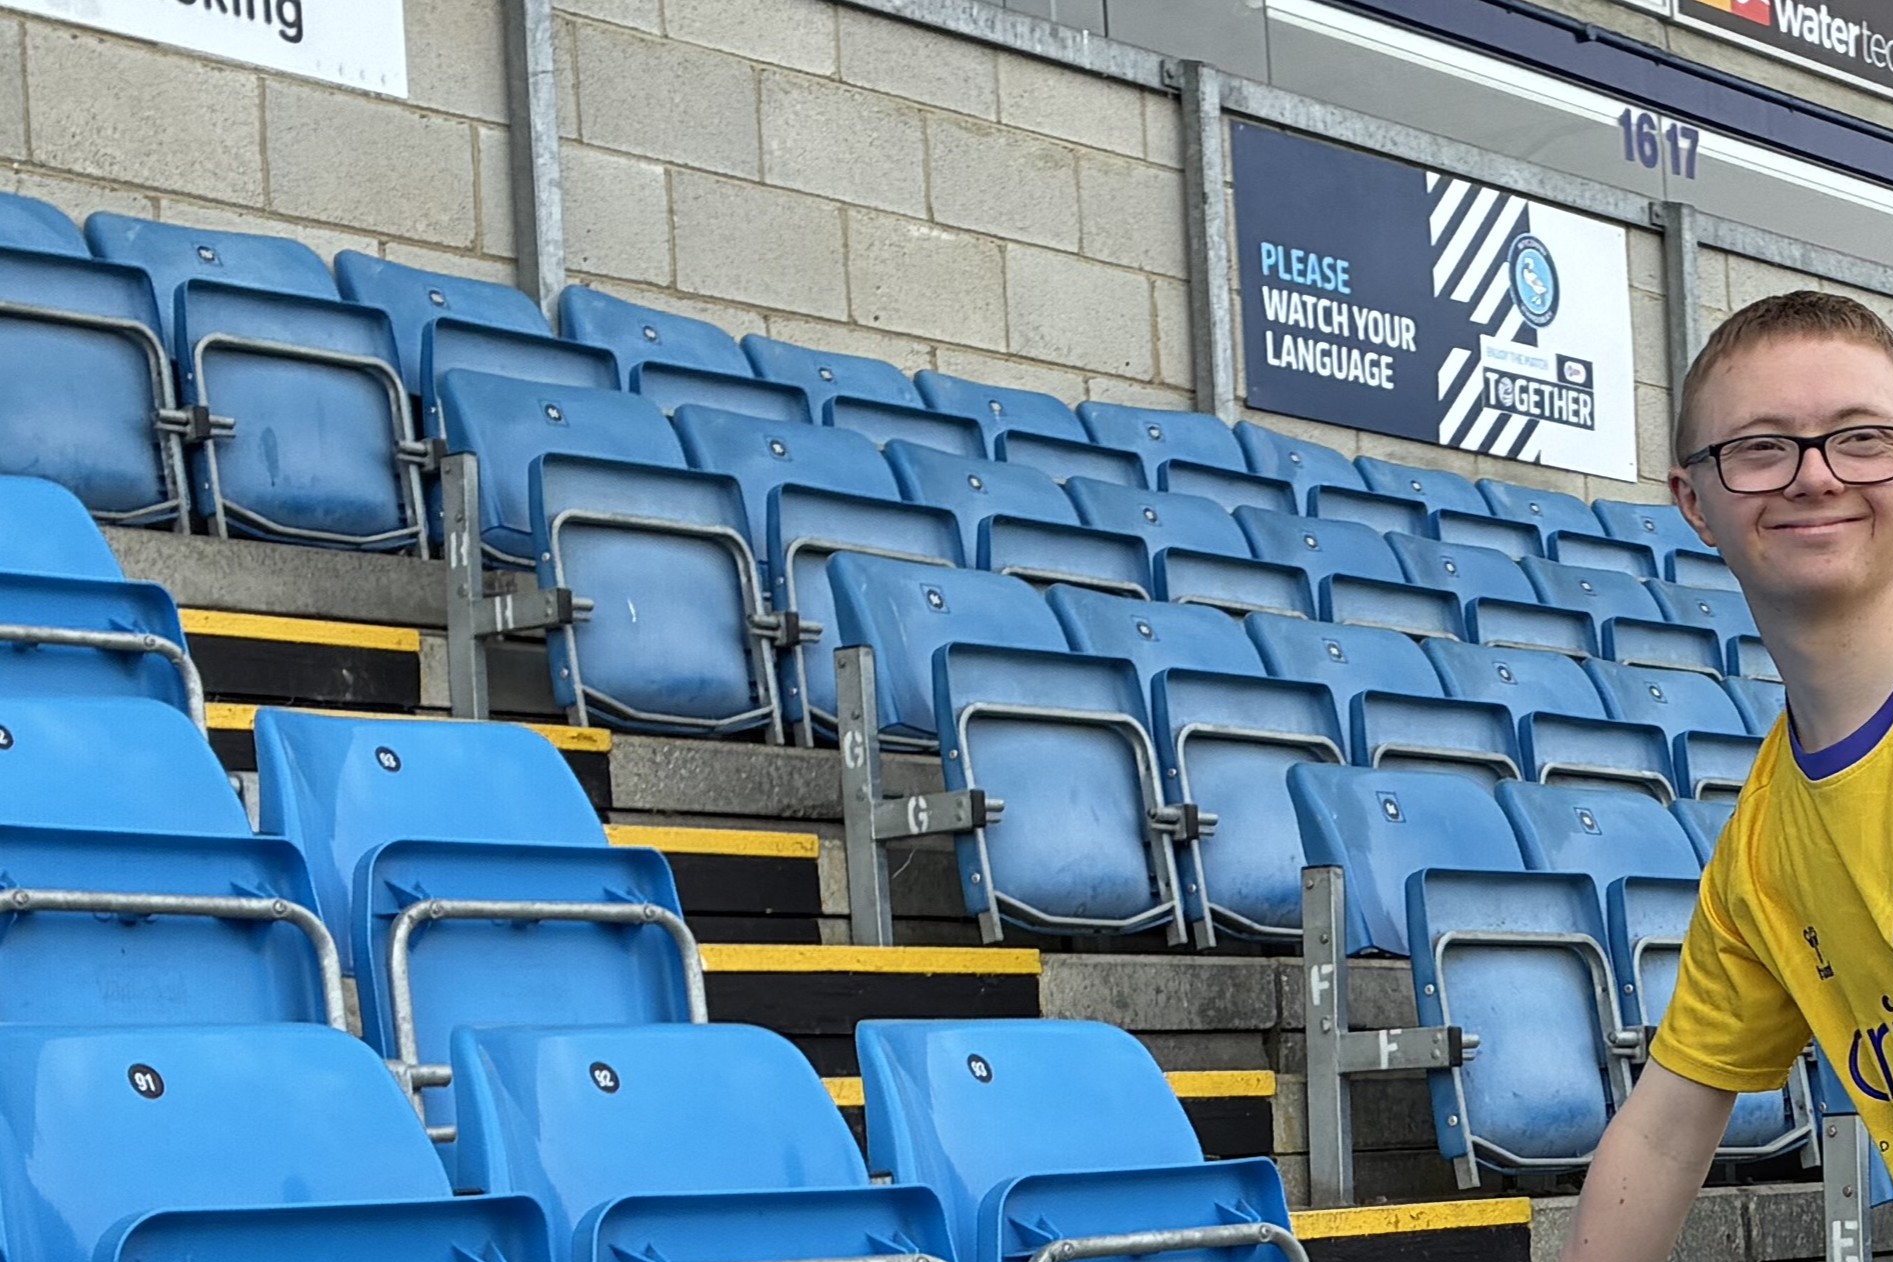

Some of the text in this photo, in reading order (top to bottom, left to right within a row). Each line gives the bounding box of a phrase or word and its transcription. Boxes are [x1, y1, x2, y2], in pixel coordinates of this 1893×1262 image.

[1618, 108, 1658, 169] 16
[1665, 122, 1699, 180] 17
[1260, 242, 1351, 294] PLEASE
[1262, 285, 1417, 352] WATCH YOUR
[1265, 330, 1395, 389] LANGUAGE
[844, 730, 864, 769] G
[908, 795, 929, 834] G
[1310, 963, 1334, 1006] F
[1379, 1028, 1402, 1069] F
[134, 1072, 156, 1092] 91
[594, 1069, 615, 1087] 92
